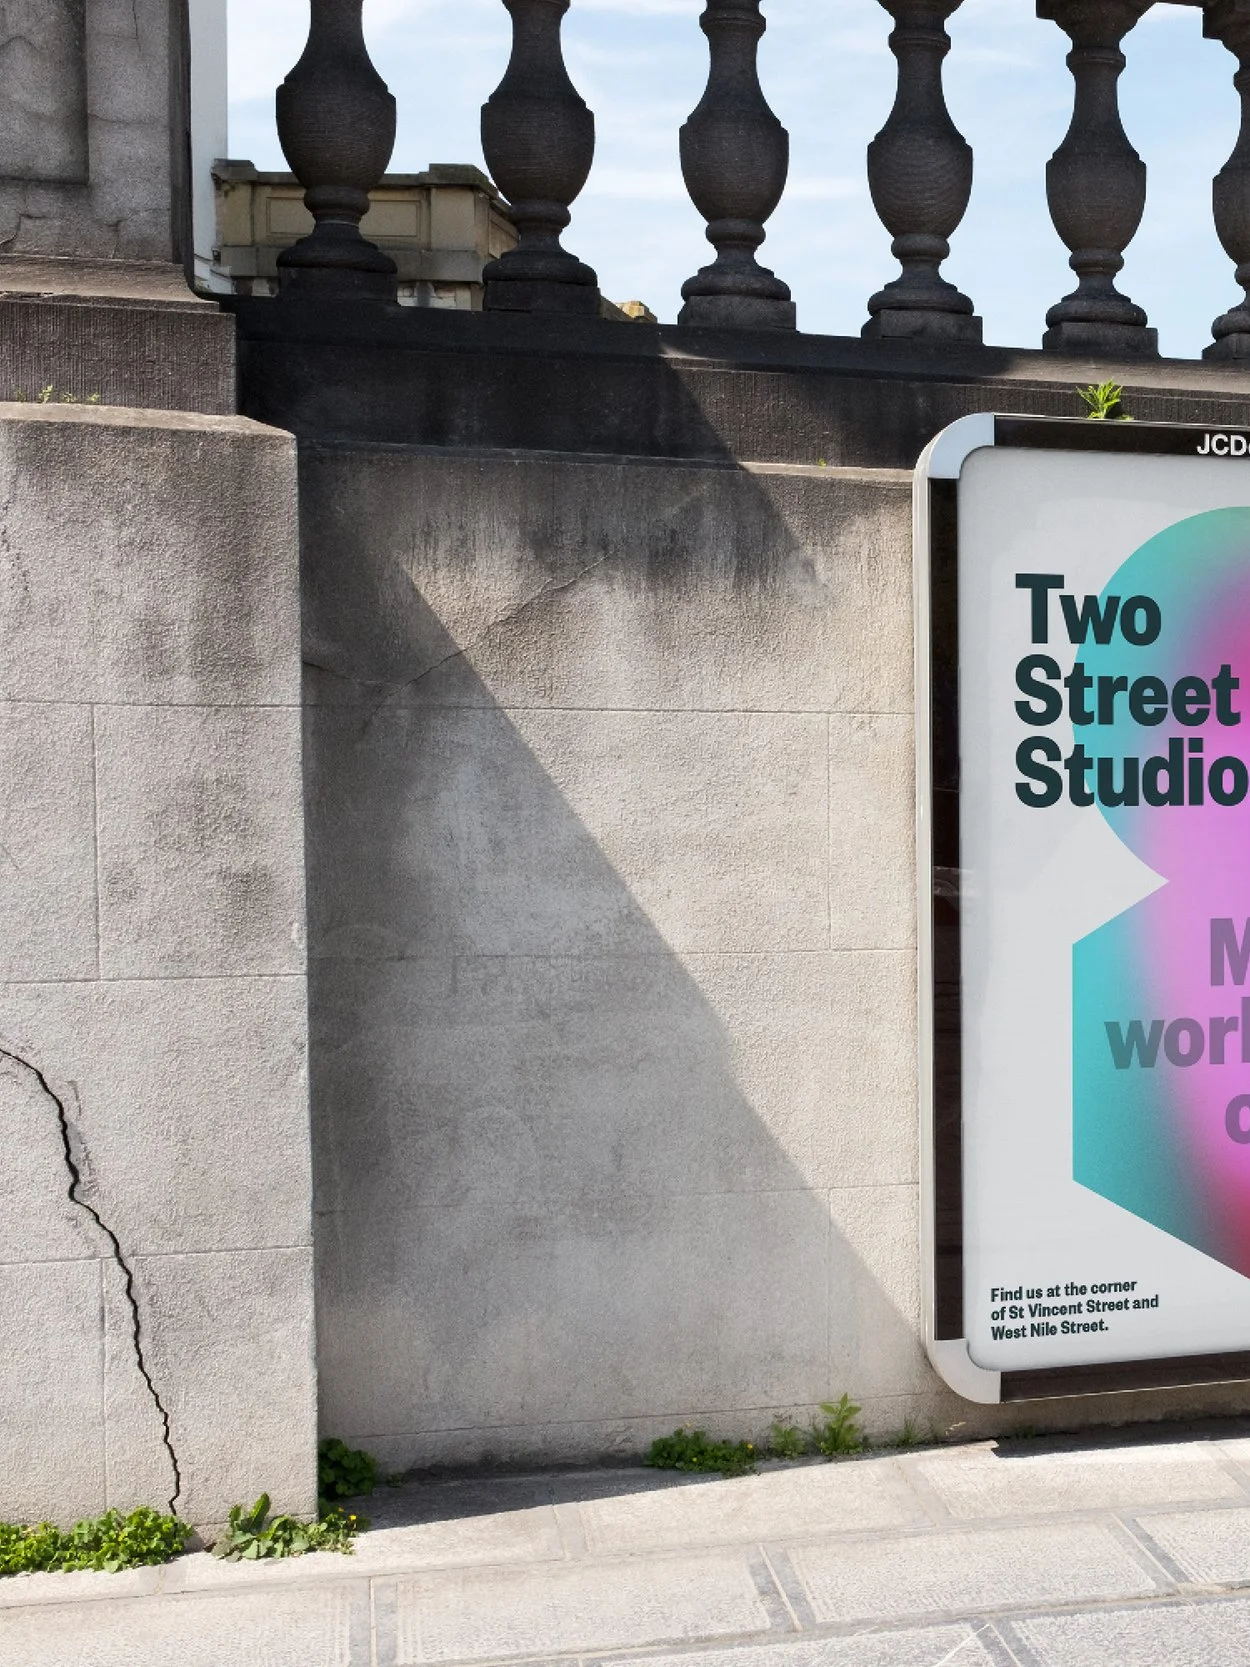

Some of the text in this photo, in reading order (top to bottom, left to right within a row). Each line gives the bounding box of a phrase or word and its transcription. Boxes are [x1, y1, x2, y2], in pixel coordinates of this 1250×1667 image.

[1015, 572, 1162, 646] Two
[1015, 653, 1241, 727] Street
[991, 1281, 1138, 1302] Find us at the corner
[991, 1294, 1159, 1321] of St Vincent Street and
[991, 1318, 1109, 1341] West Nile Street.
